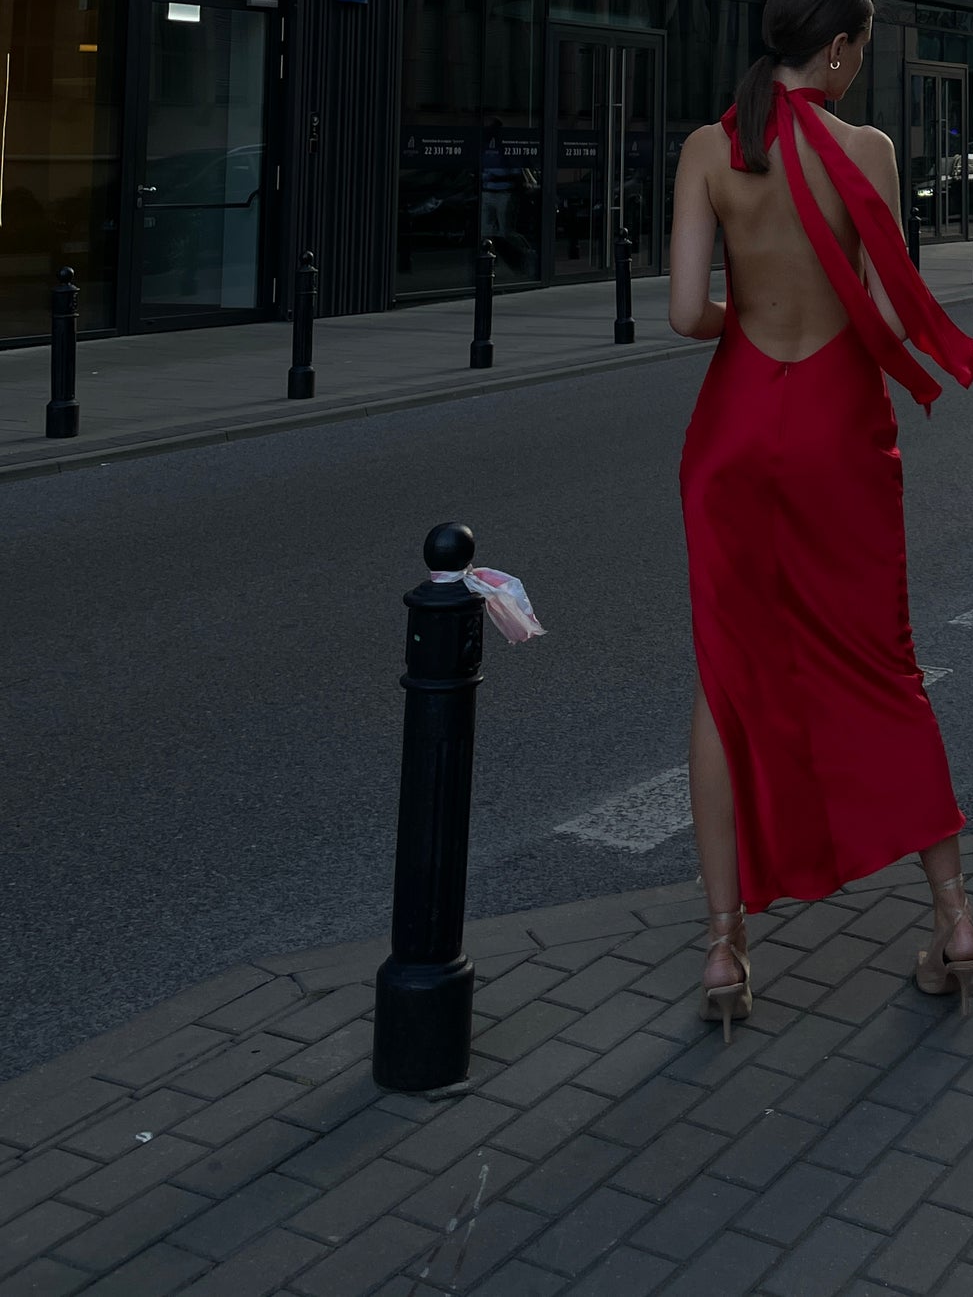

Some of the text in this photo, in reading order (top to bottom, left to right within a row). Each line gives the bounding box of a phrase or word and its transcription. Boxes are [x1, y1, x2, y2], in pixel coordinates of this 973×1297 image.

[424, 146, 432, 155] 22
[504, 147, 512, 155] 22
[565, 148, 572, 156] 22
